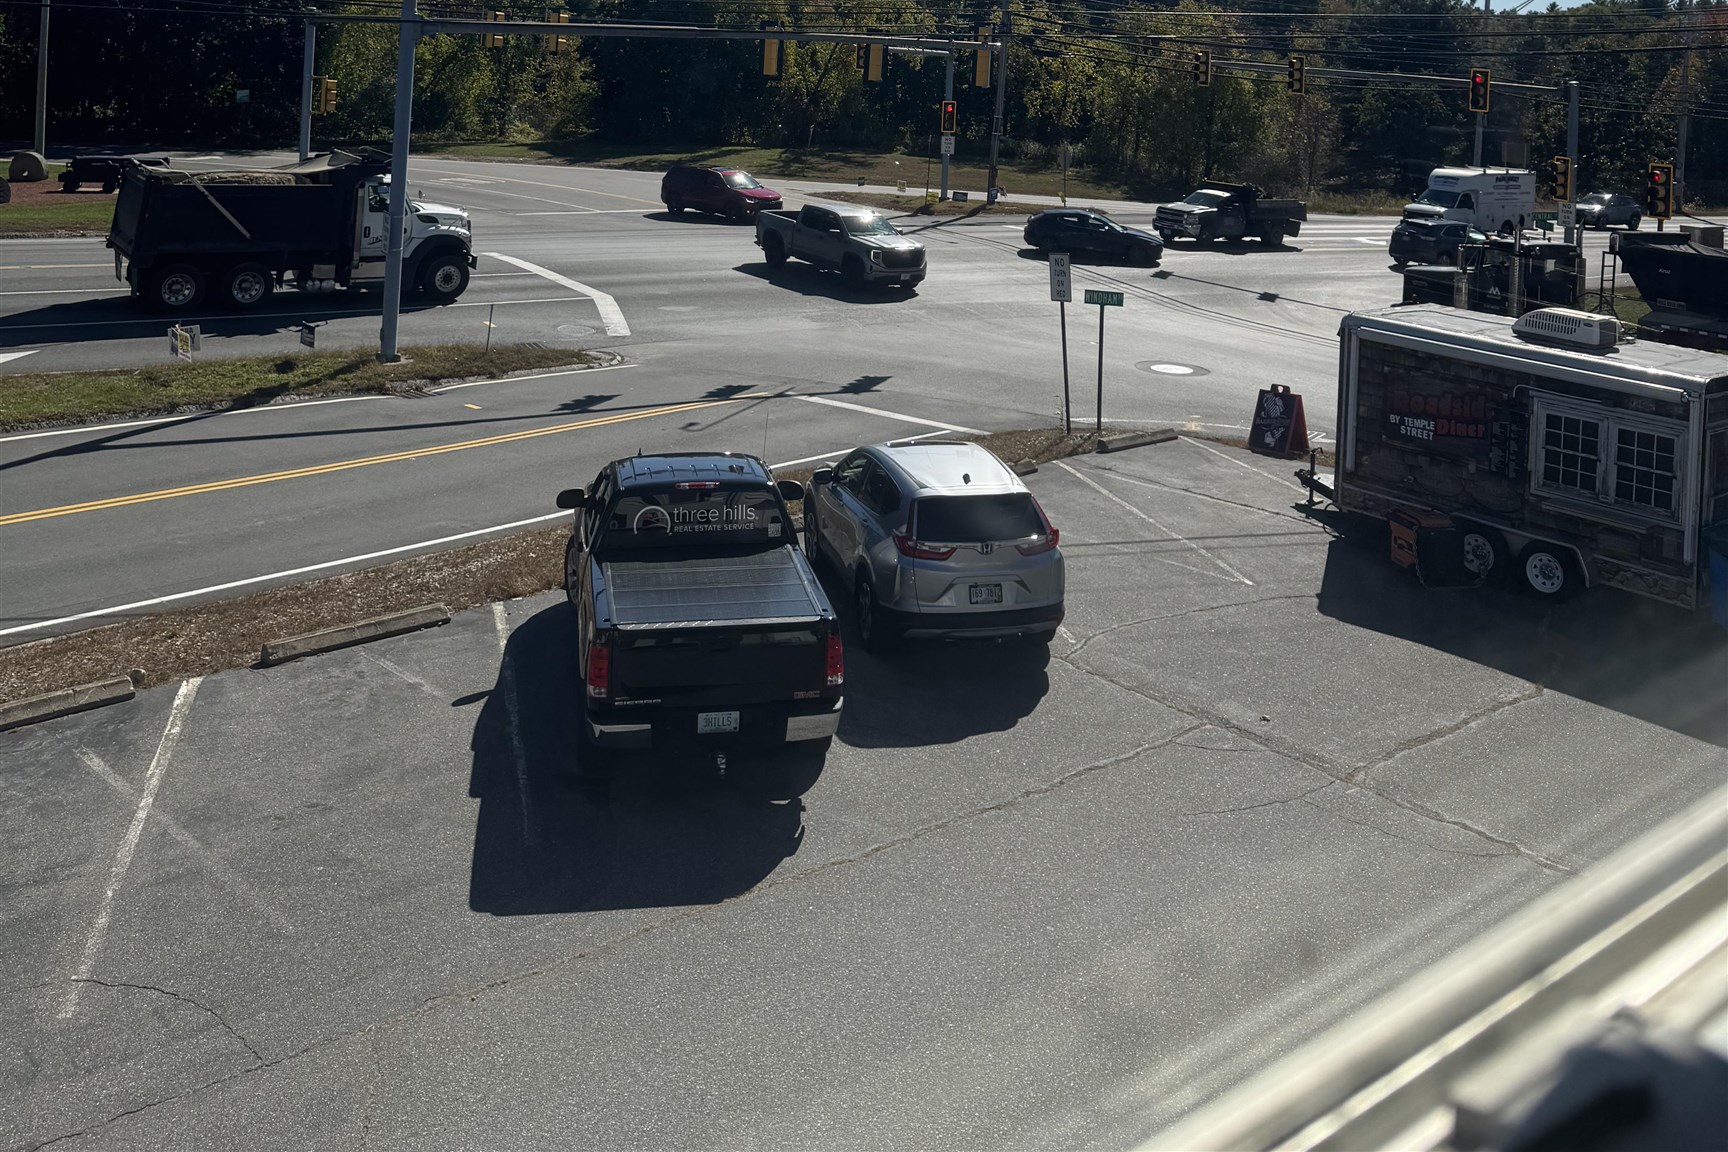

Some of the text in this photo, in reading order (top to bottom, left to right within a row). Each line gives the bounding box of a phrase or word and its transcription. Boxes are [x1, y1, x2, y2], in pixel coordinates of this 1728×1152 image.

[1054, 257, 1065, 267] NO
[1054, 269, 1067, 278] TURN
[1056, 279, 1065, 287] ON
[1056, 289, 1066, 298] RED
[1085, 291, 1118, 304] WINDHAM
[1389, 414, 1436, 431] BY TEMPLE
[1436, 418, 1485, 438] Diner
[1400, 425, 1434, 441] STREET
[673, 506, 719, 523] three
[673, 522, 755, 533] REAL ESTATE SERVICE
[703, 715, 732, 728] 3HILLS
